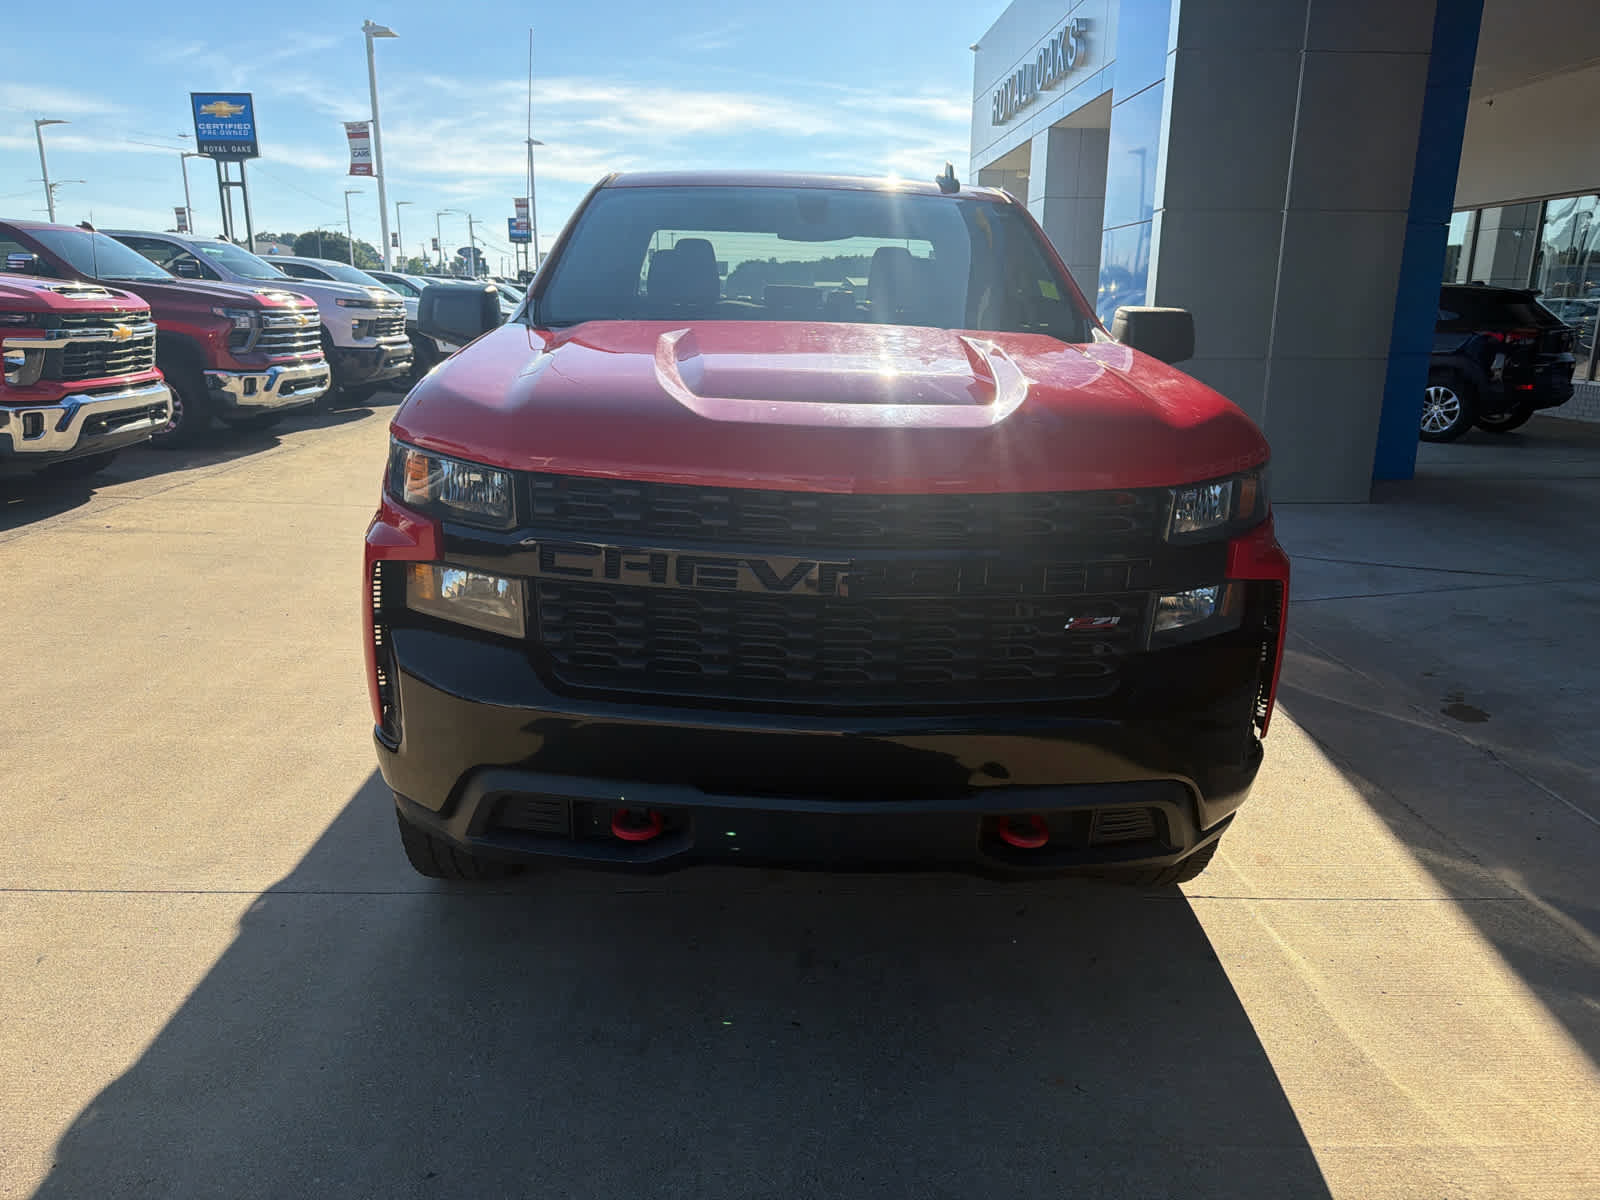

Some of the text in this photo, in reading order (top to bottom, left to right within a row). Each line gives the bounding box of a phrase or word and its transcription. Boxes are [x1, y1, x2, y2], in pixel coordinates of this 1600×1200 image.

[992, 18, 1087, 126] ROYAL OAKS
[203, 144, 227, 152] ROYAL
